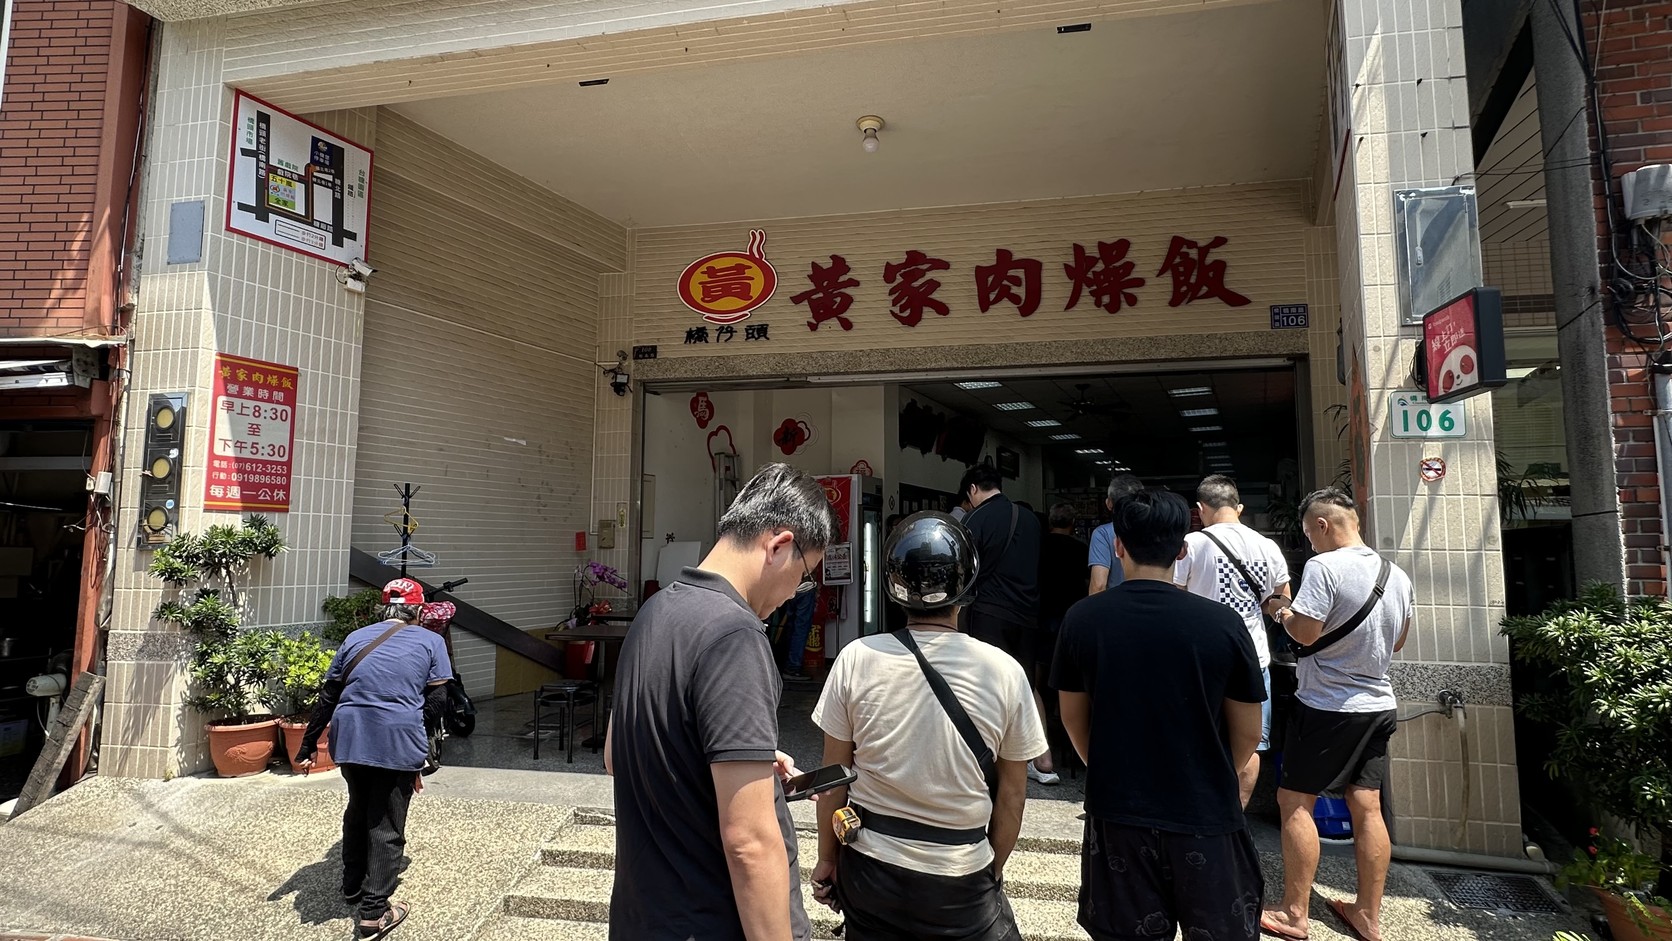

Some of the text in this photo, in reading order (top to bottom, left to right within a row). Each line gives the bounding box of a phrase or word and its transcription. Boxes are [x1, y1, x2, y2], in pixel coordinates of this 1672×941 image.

[698, 263, 755, 303] 黃
[790, 235, 1252, 331] 黃家肉燥飯
[1282, 316, 1306, 326] 106
[218, 366, 294, 390] 黃家肉燥飯
[226, 384, 284, 402] 營業時間
[220, 400, 288, 422] 早上8:30
[1402, 409, 1454, 432] 106
[247, 422, 261, 437] 至
[218, 438, 286, 458] 下午5:30
[210, 484, 286, 501] 每週一公休
